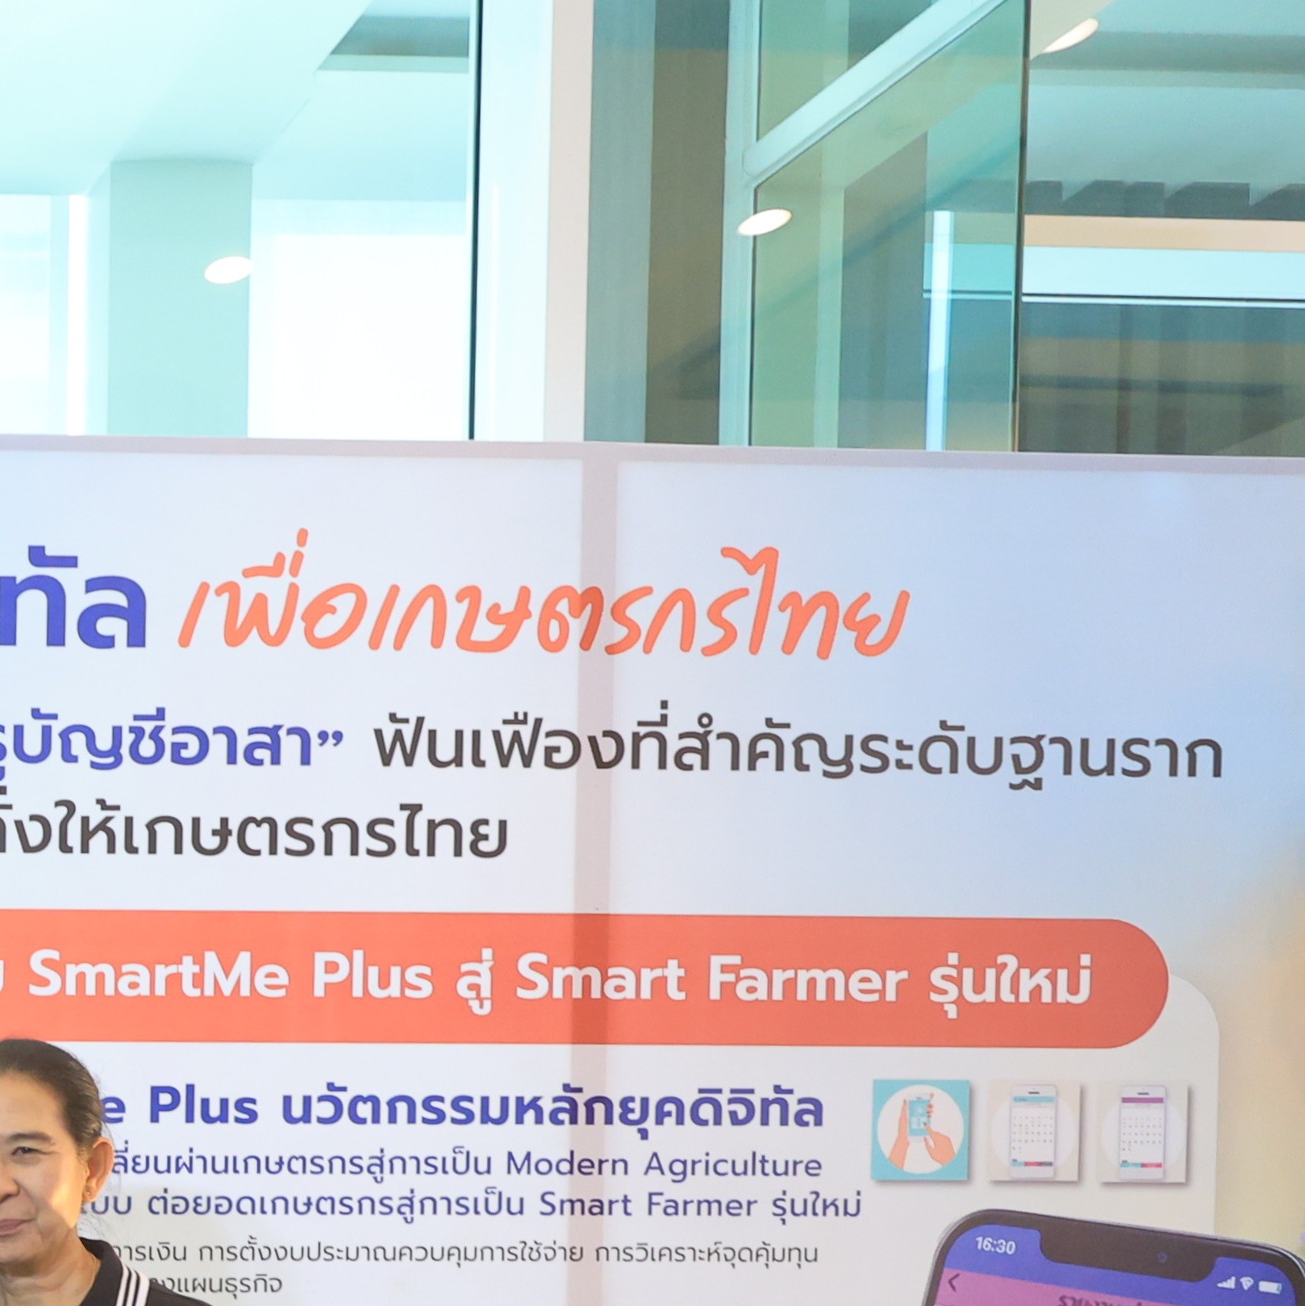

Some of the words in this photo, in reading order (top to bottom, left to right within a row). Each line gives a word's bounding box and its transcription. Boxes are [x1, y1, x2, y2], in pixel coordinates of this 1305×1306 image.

[177, 527, 911, 660] เพื่อเกษตรกรไทย
[374, 700, 1223, 791] ฟันเฟืองที่สำคัญระดับฐานราก
[27, 948, 290, 999] SmartMe
[311, 952, 433, 1000] Plus
[455, 941, 494, 1015] สู่
[515, 954, 687, 1002] Smart
[708, 954, 909, 1004] Farmer
[928, 953, 1092, 1019] รุ่นใหม่
[149, 1084, 259, 1124] Plus
[282, 1081, 824, 1141] นวัตกรรมหลักยุคดิจิทัล
[506, 1150, 629, 1176] Modern
[643, 1151, 823, 1183] Agriculture
[147, 1186, 525, 1225] ต่อยอดเกษตรกรสู่การเป็น
[539, 1190, 633, 1217] Smart
[647, 1191, 759, 1217] Farmer
[771, 1189, 862, 1226] รุ่นใหม่
[198, 1235, 584, 1268] การตั้งงบประมาณควบคุมการใช้จ่าย
[595, 1241, 819, 1270] การวิเคราะห์จุดคุ้มทุน
[975, 1236, 1016, 1255] 16:30
